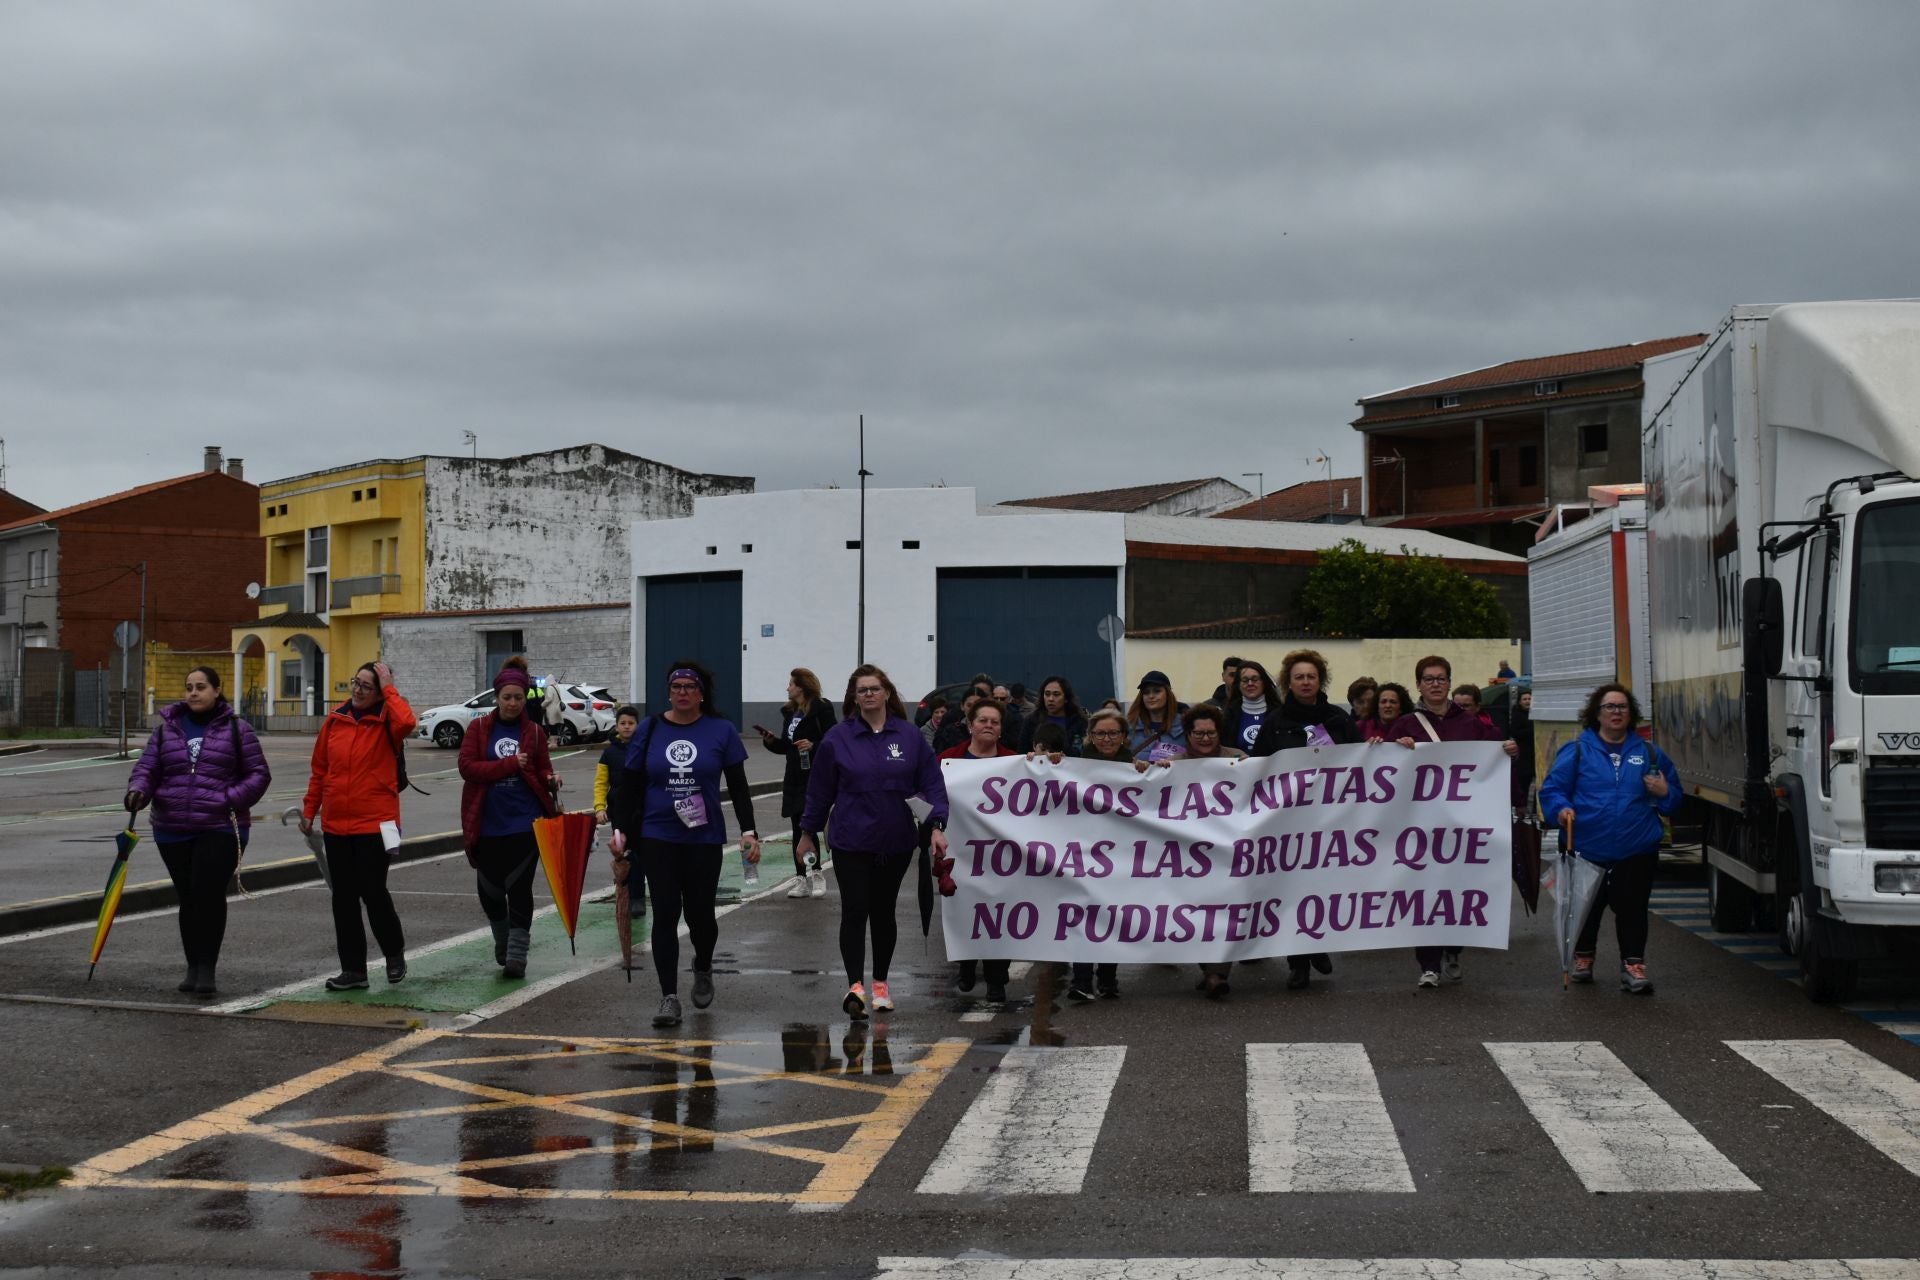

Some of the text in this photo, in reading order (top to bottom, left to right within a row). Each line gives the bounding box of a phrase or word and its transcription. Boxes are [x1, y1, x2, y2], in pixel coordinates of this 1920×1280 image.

[1161, 743, 1178, 752] 175
[976, 764, 1477, 820] SOMOS LAS NIETAS DE
[965, 826, 1494, 879] TODAS LAS BRUJAS QUE
[970, 889, 1489, 943] NO PUDISTEIS QUEMAR
